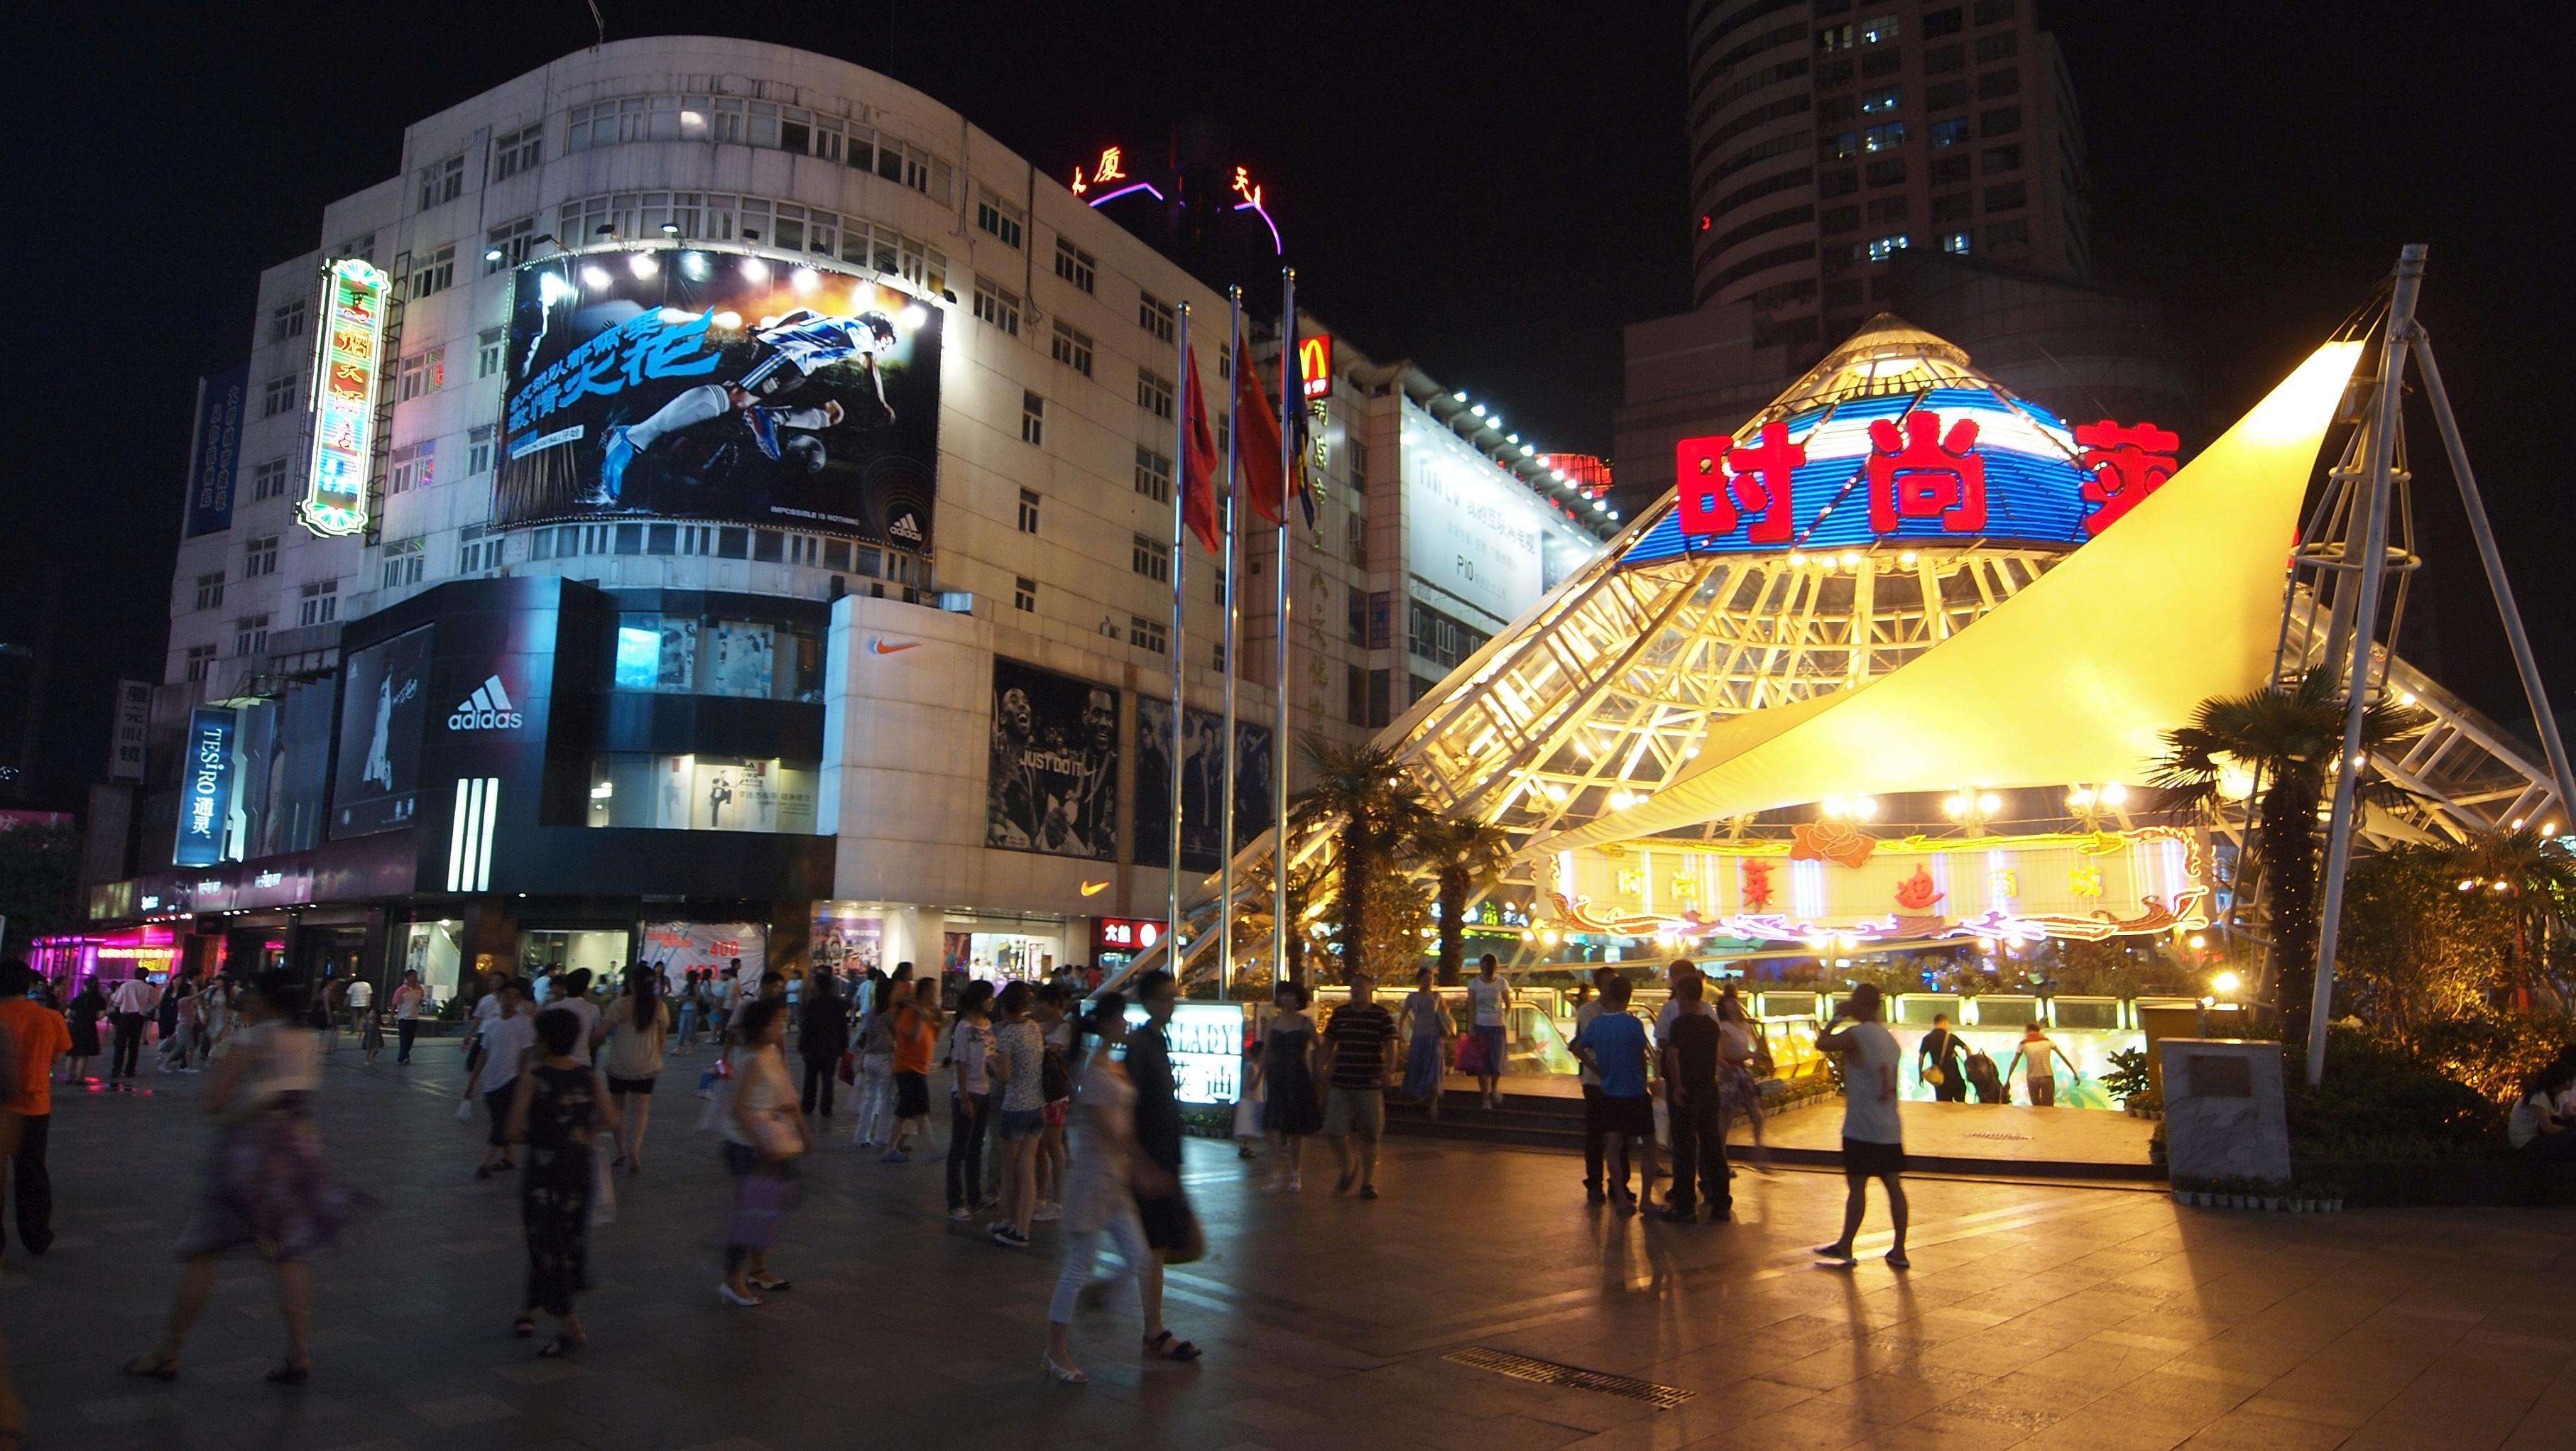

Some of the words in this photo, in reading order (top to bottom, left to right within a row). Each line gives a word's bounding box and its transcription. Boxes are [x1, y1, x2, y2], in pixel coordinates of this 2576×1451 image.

[770, 505, 817, 519] IMPOSSIBLE
[826, 513, 860, 526] NOTHING
[889, 525, 922, 542] adidas
[448, 708, 523, 730] adidas
[1019, 749, 1054, 771] JUST
[1054, 757, 1071, 775] DO
[1071, 760, 1084, 777] IT
[190, 796, 215, 835] 通灵
[709, 941, 739, 957] 400
